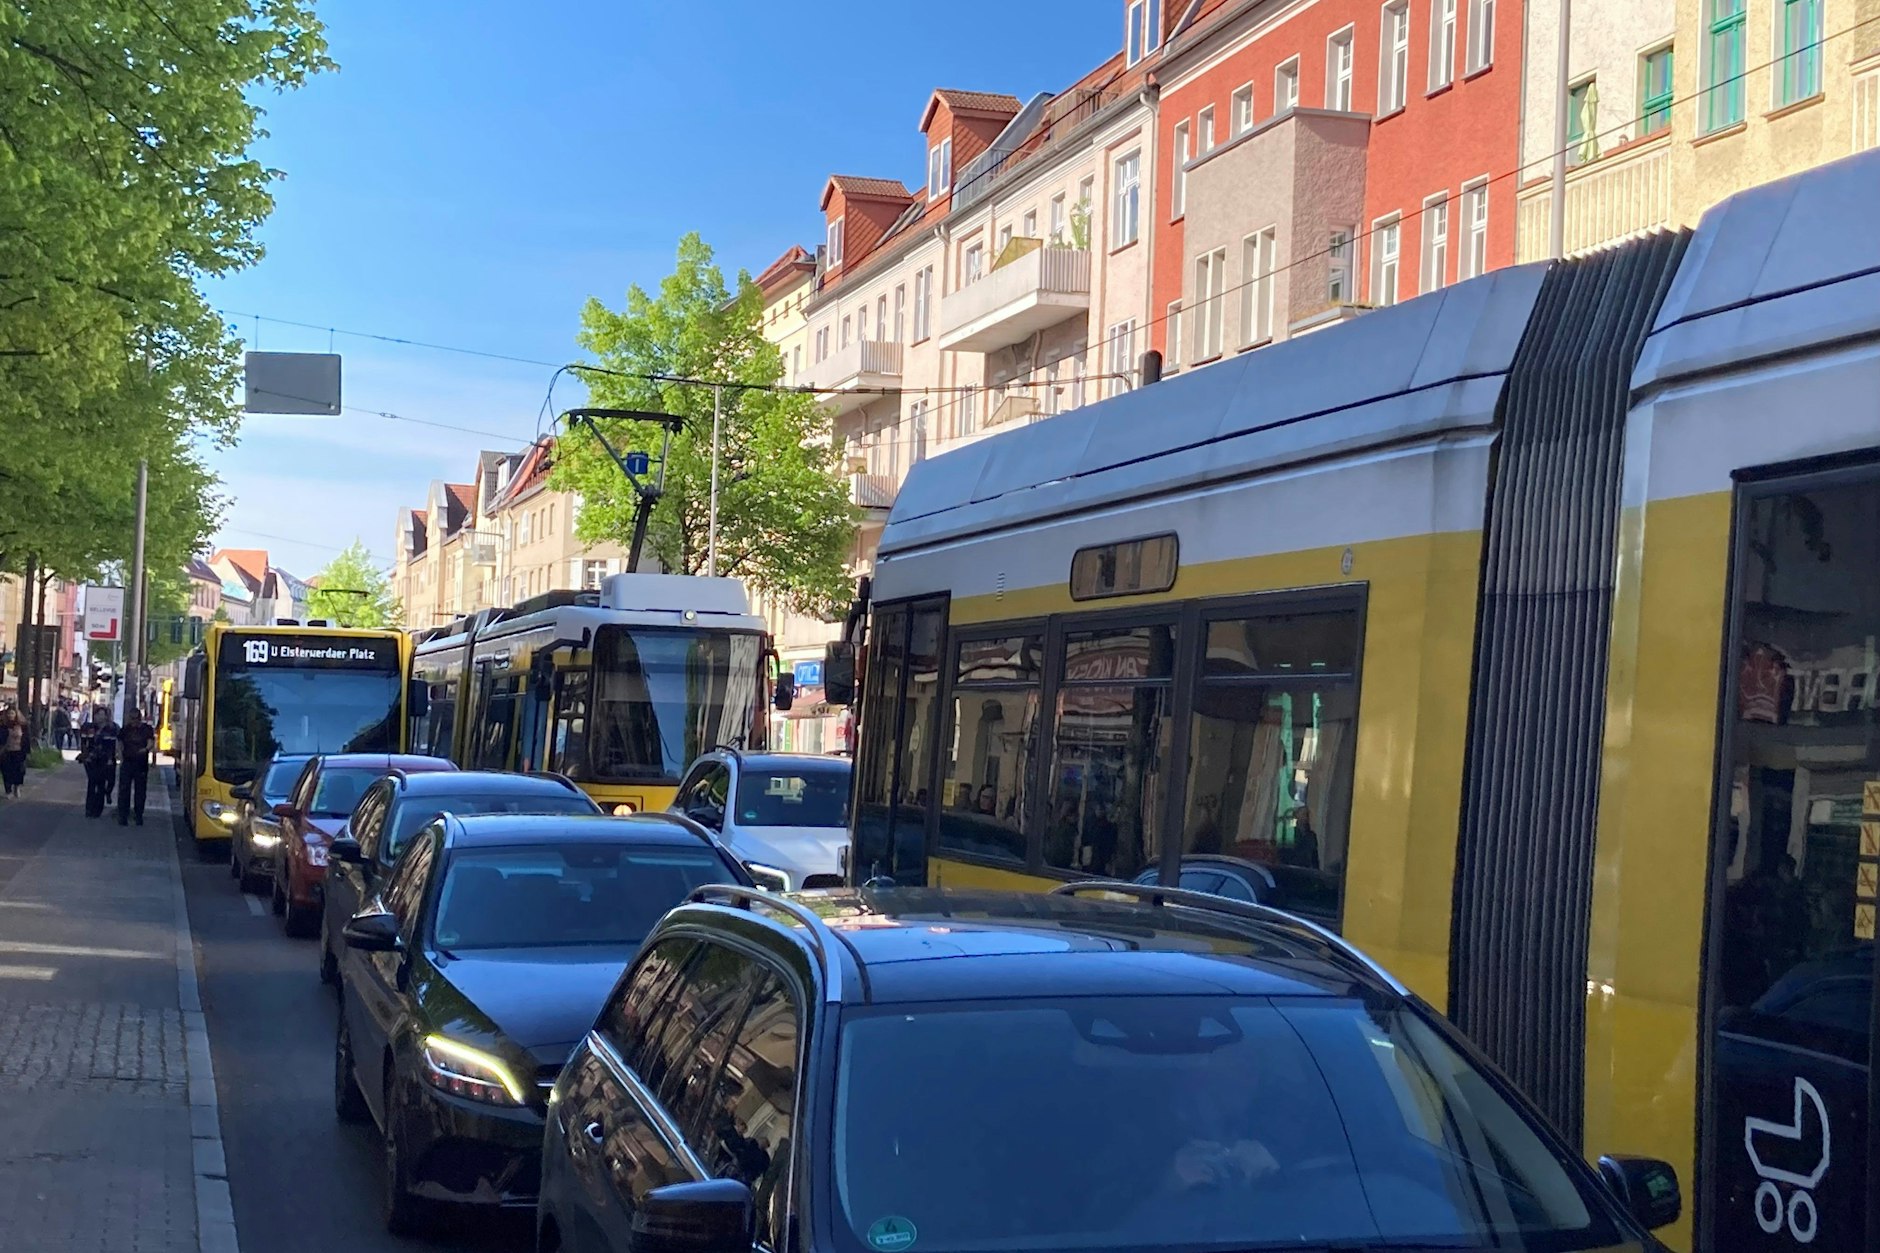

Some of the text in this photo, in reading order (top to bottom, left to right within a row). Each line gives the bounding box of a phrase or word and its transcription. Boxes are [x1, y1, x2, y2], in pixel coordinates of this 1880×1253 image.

[243, 640, 375, 663] 169 U Elsterwerdaer Platz
